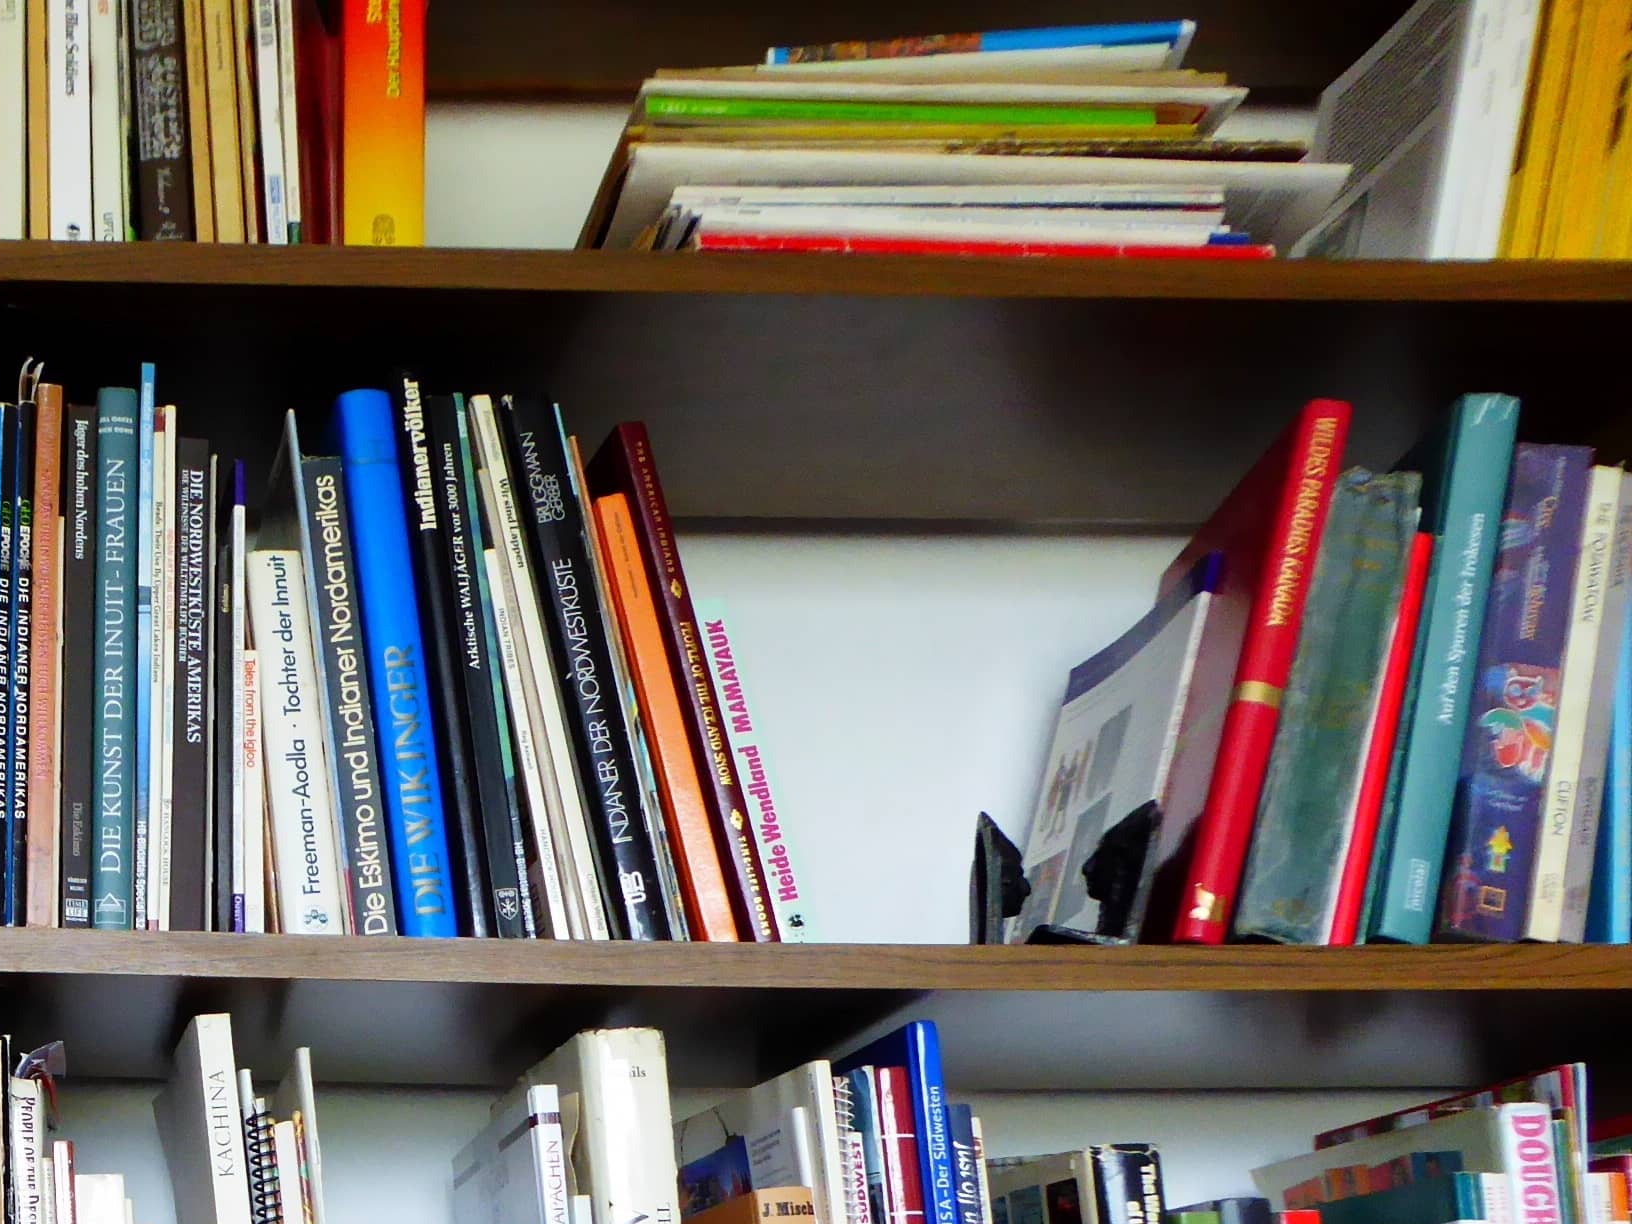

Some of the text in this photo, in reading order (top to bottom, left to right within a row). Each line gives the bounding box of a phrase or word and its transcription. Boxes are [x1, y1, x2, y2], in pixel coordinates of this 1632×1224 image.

[74, 510, 87, 560] Nordens
[105, 458, 125, 563] FRAUEN
[403, 378, 438, 530] Indianervölker
[1266, 416, 1338, 627] WILDES PARADIES KANADA
[184, 470, 204, 743] DIE NORDWESTKÜSTE AMERIKAS
[441, 442, 481, 670] Arktische WALJÄGER vor 3000 Jahren
[102, 664, 123, 721] DER
[102, 727, 123, 818] KUNST
[268, 555, 321, 895] Freeman-Aodla Tochter der Innuit
[314, 475, 389, 934] Die Eskimo und Indianer Nordamerikas
[382, 643, 447, 916] DIE WIKINGER
[552, 558, 633, 842] INDIANER DER NORDWESTKÜSTE
[705, 620, 798, 902] Heide Wendland MAMAYAUK
[102, 825, 121, 874] DIE
[208, 1069, 234, 1178] KACHINA
[545, 1140, 564, 1224] APACHEN
